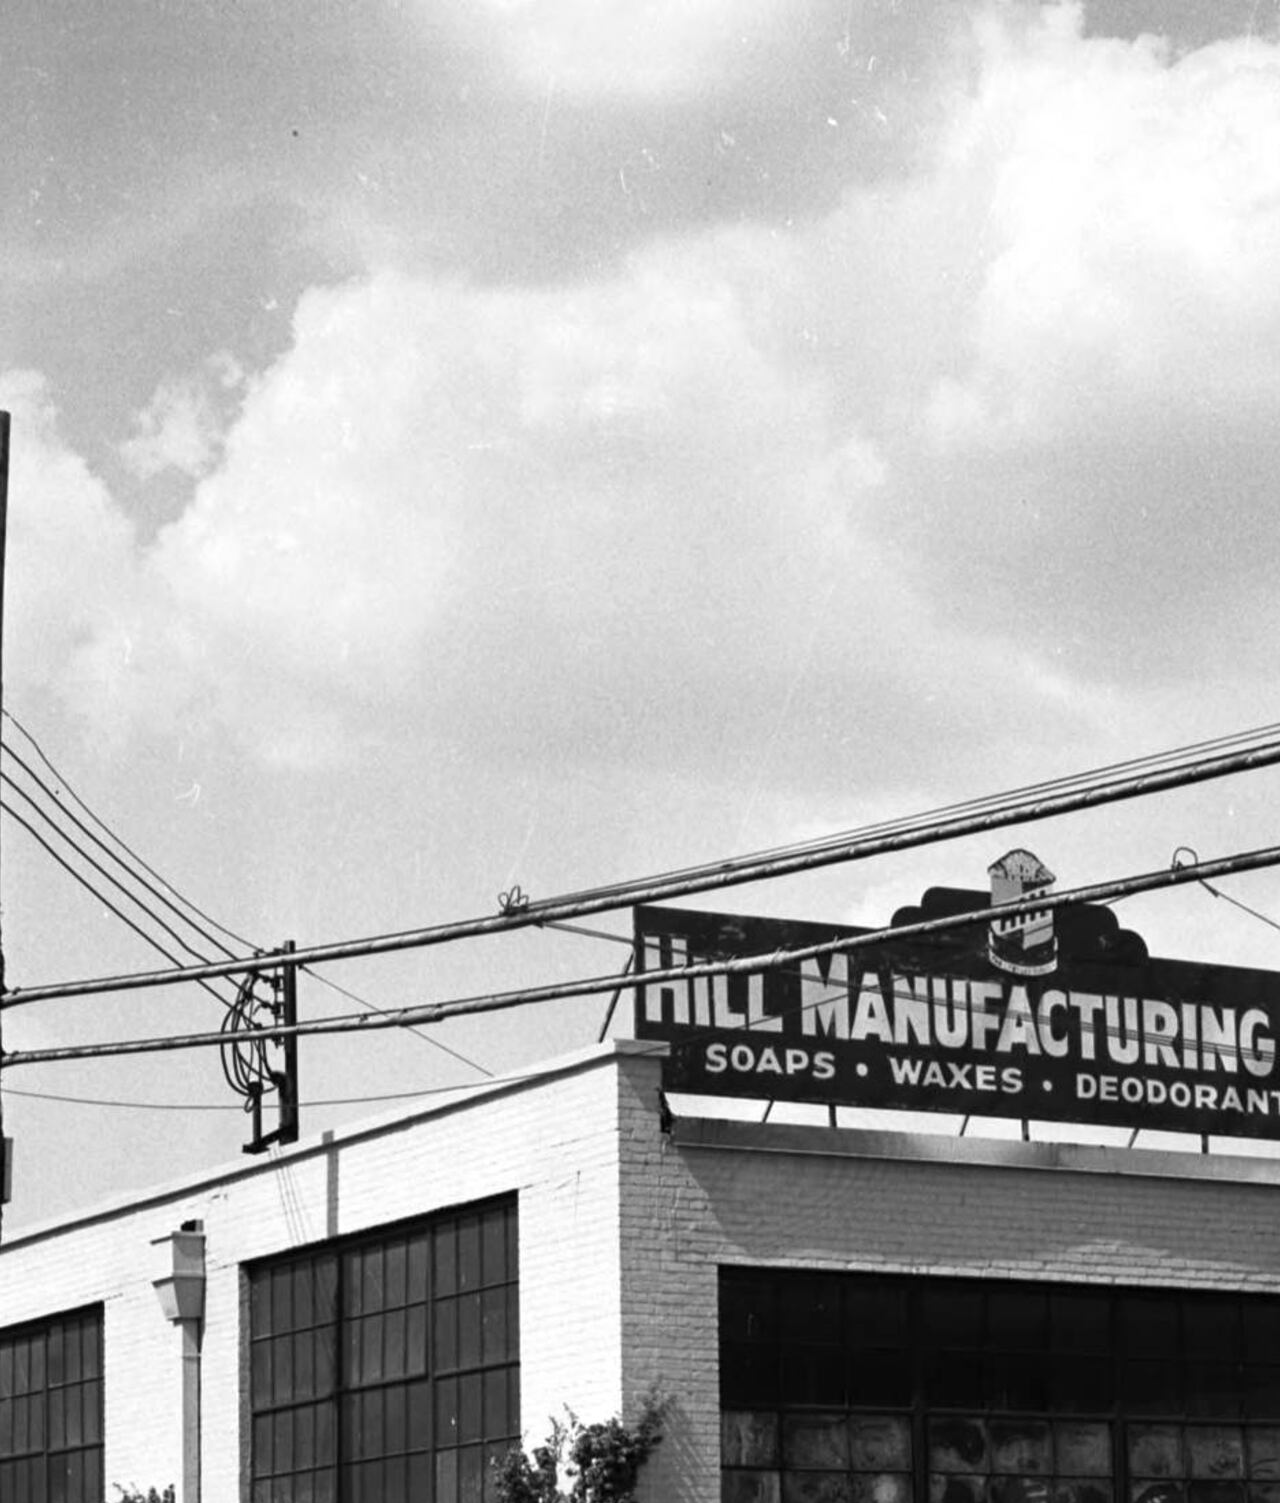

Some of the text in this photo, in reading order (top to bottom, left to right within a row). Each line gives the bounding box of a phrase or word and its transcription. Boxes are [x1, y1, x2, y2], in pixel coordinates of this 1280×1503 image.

[643, 935, 784, 1033] HILL
[799, 952, 1276, 1077] MANUFACTURING
[705, 1043, 837, 1079] SOAPS
[888, 1056, 1024, 1094] WAXES
